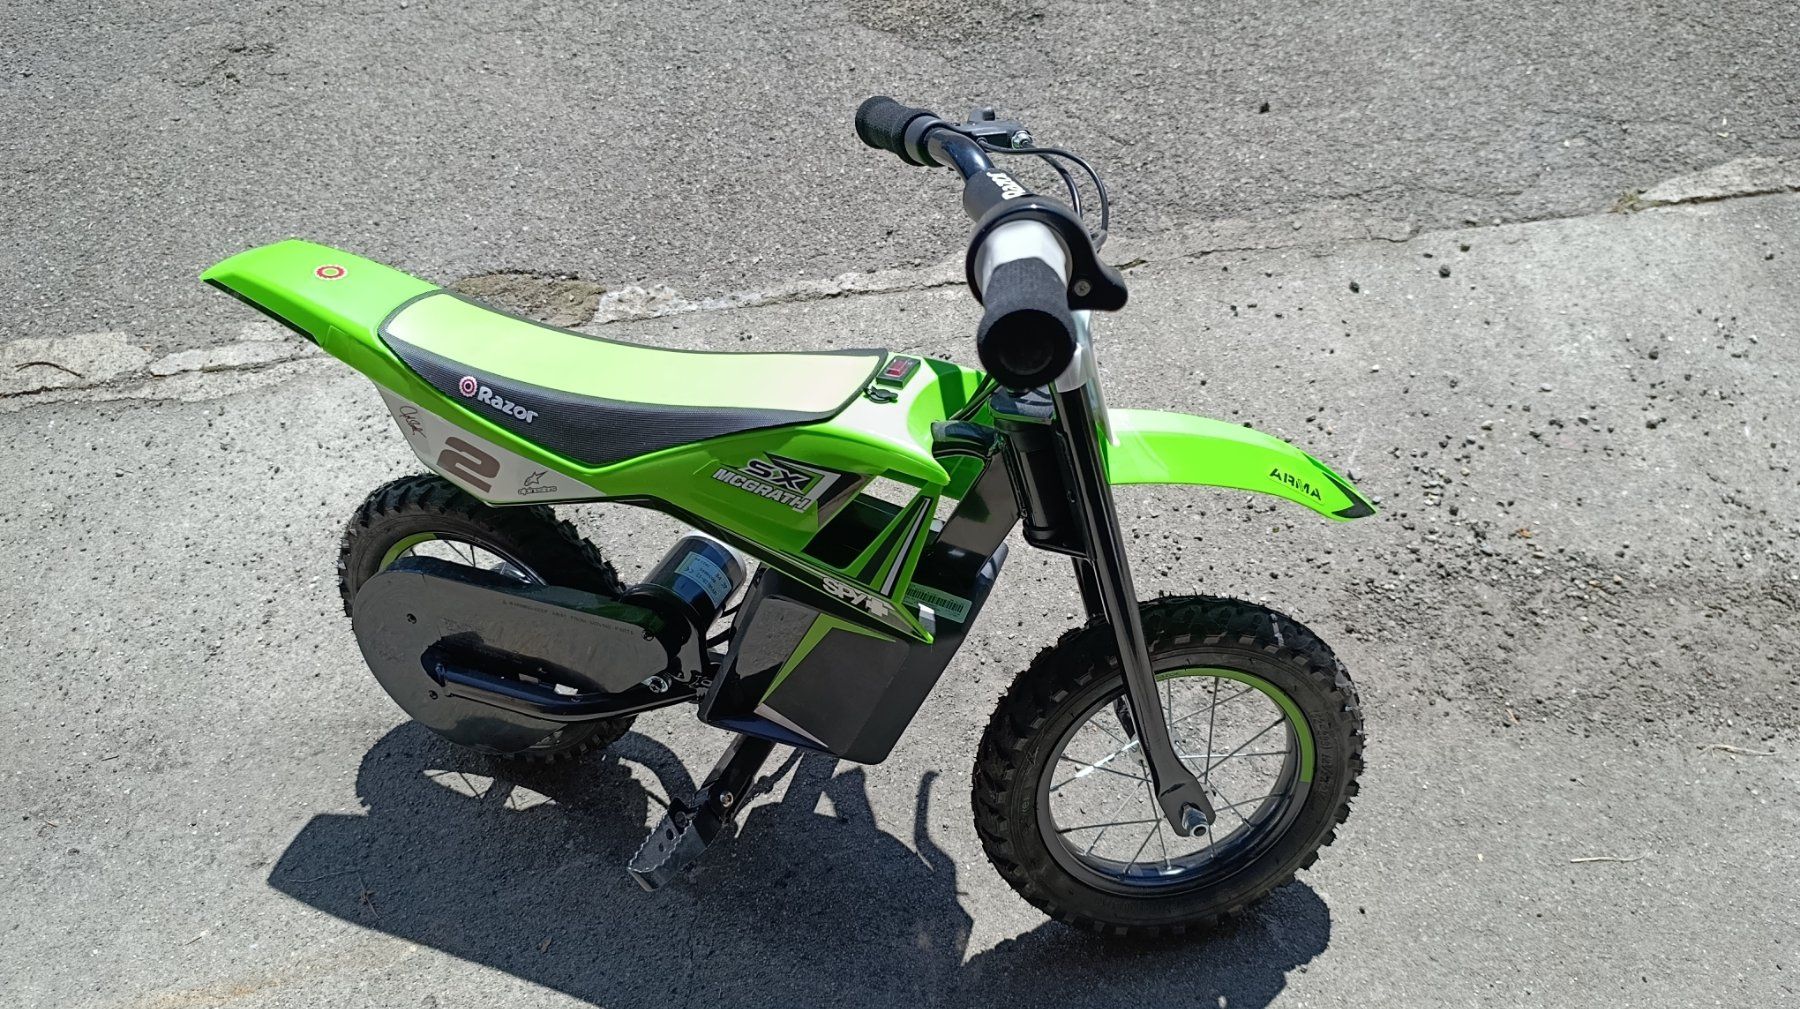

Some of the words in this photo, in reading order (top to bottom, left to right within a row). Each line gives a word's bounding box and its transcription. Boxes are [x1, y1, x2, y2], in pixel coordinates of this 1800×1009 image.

[986, 171, 1027, 200] Razor
[477, 386, 539, 424] Razor
[436, 436, 501, 493] 2
[712, 468, 812, 513] MCGRATH
[1269, 468, 1322, 501] ARMA
